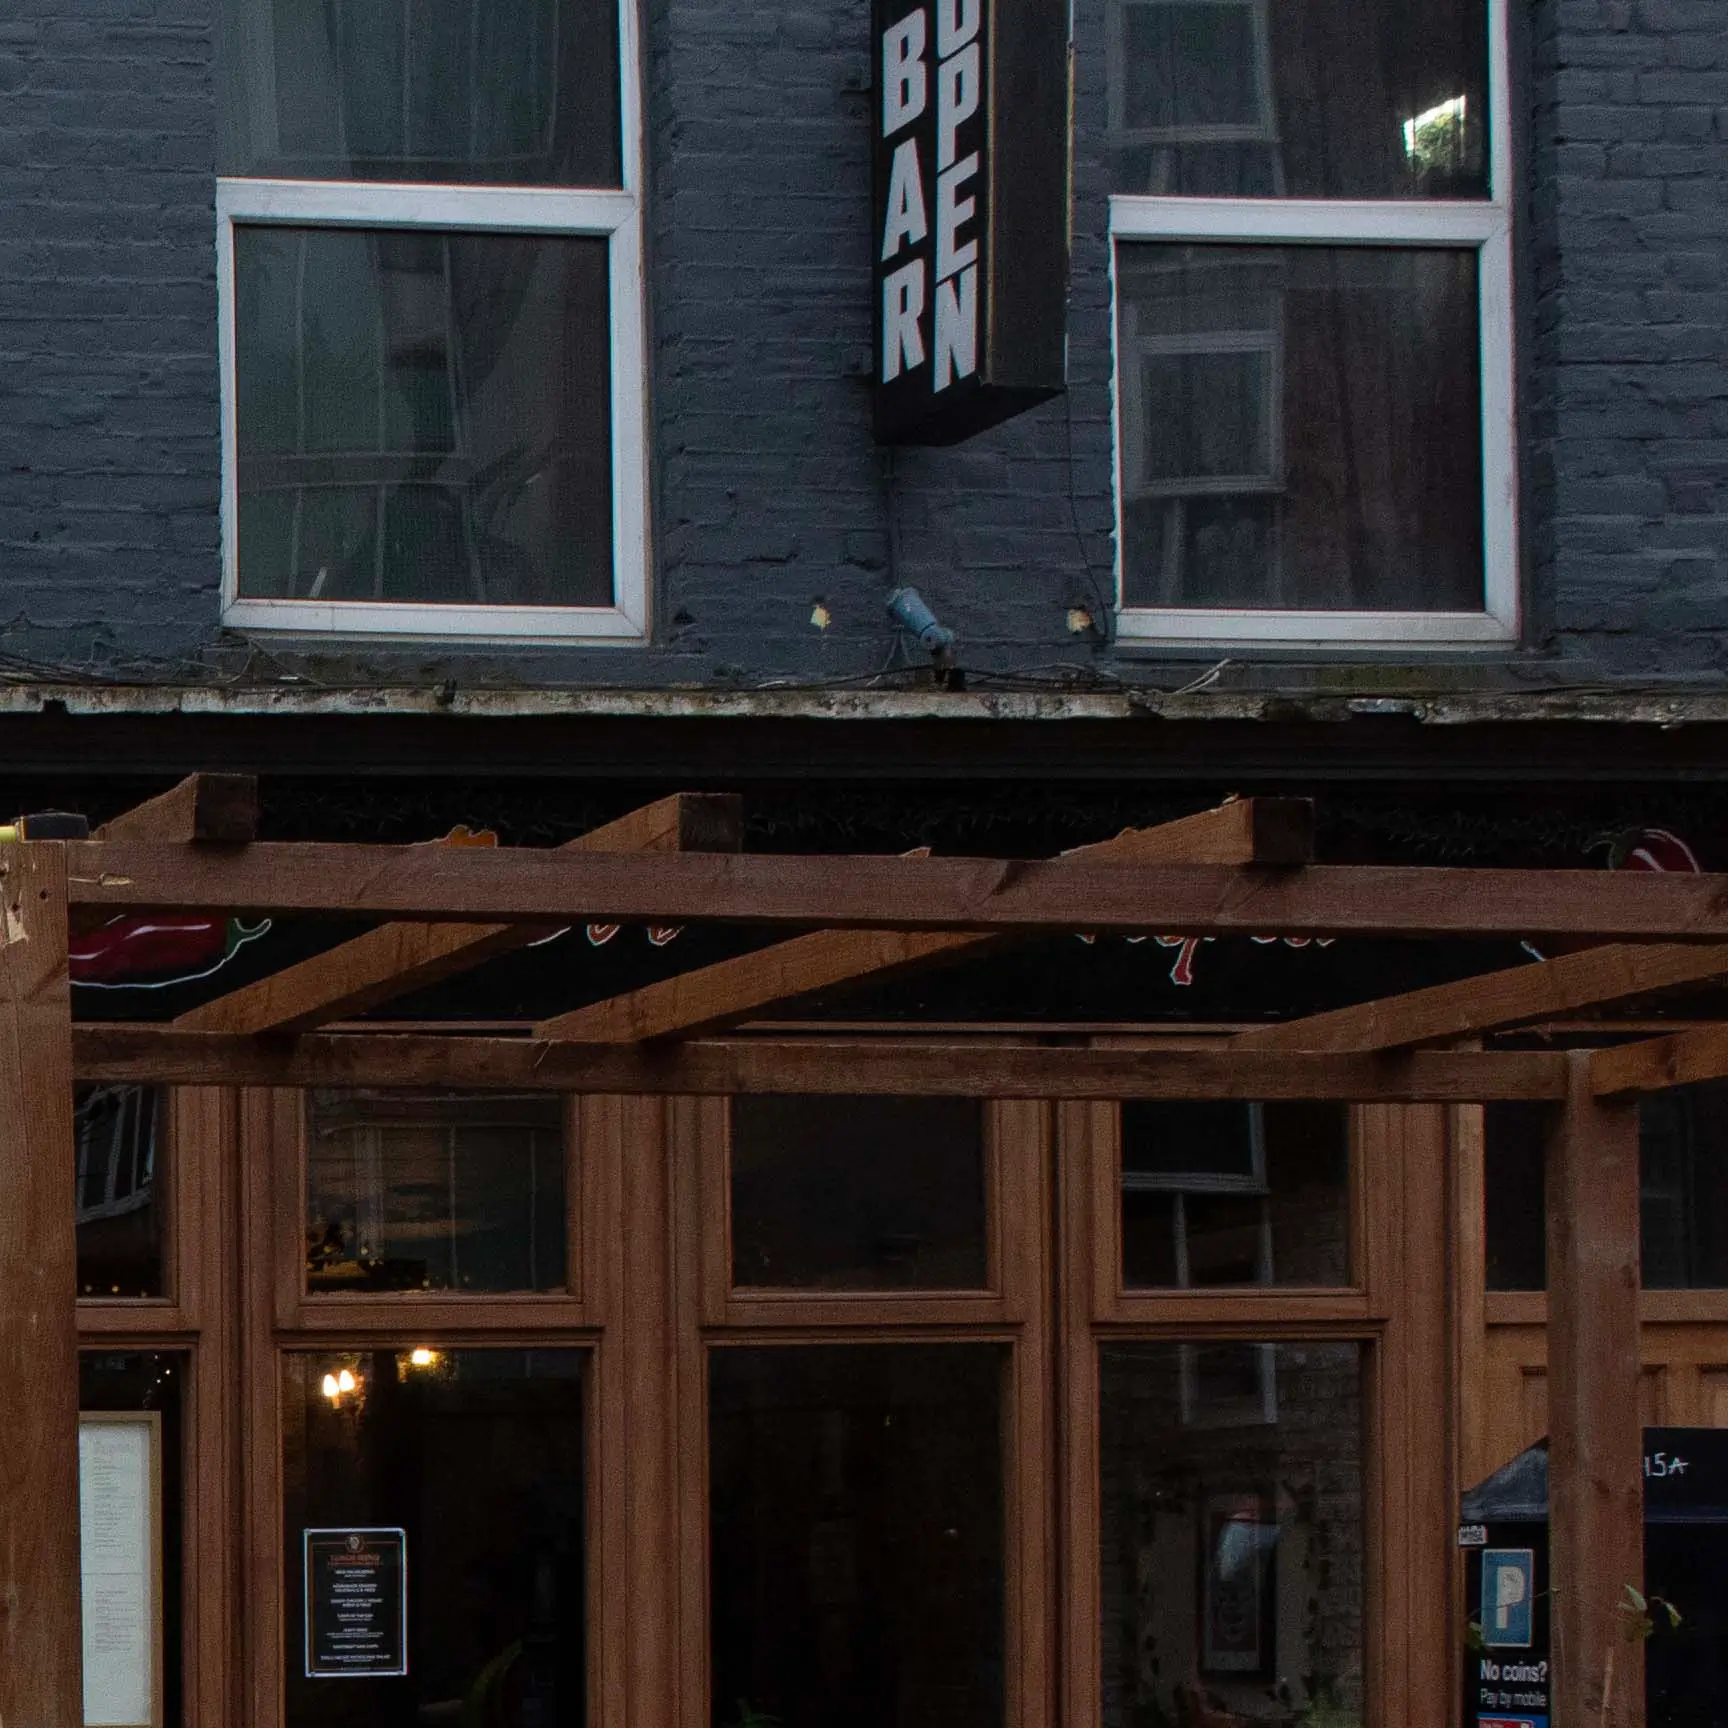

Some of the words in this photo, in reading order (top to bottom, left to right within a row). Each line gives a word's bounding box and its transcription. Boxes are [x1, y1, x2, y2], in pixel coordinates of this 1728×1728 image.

[881, 8, 928, 385] BAR
[1496, 1566, 1525, 1629] P
[1480, 1658, 1500, 1681] No
[1502, 1660, 1548, 1682] coins?
[1480, 1688, 1496, 1708] Pay
